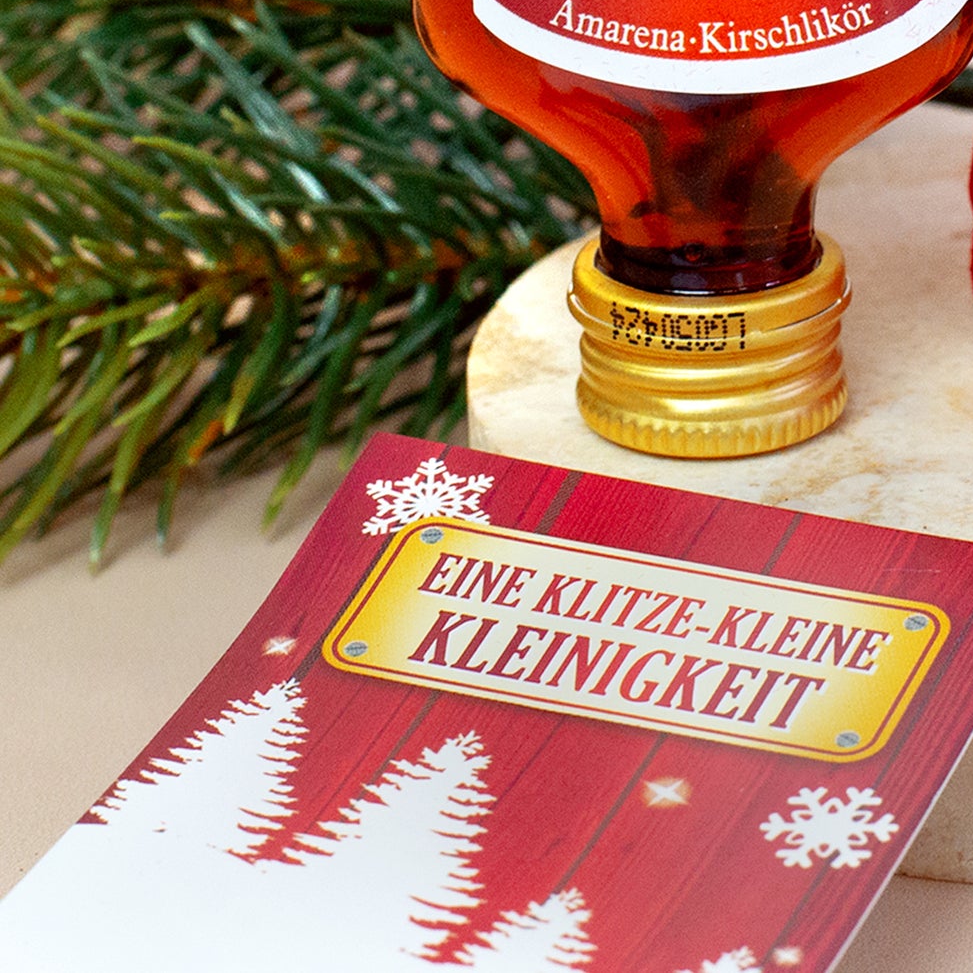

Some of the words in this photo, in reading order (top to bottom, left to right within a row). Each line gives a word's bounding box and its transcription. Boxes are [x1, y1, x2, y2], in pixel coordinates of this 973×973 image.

[417, 552, 537, 608] EINE
[533, 578, 891, 668] KLITZE-KLEINE
[408, 610, 826, 729] KLEINIGKEIT
